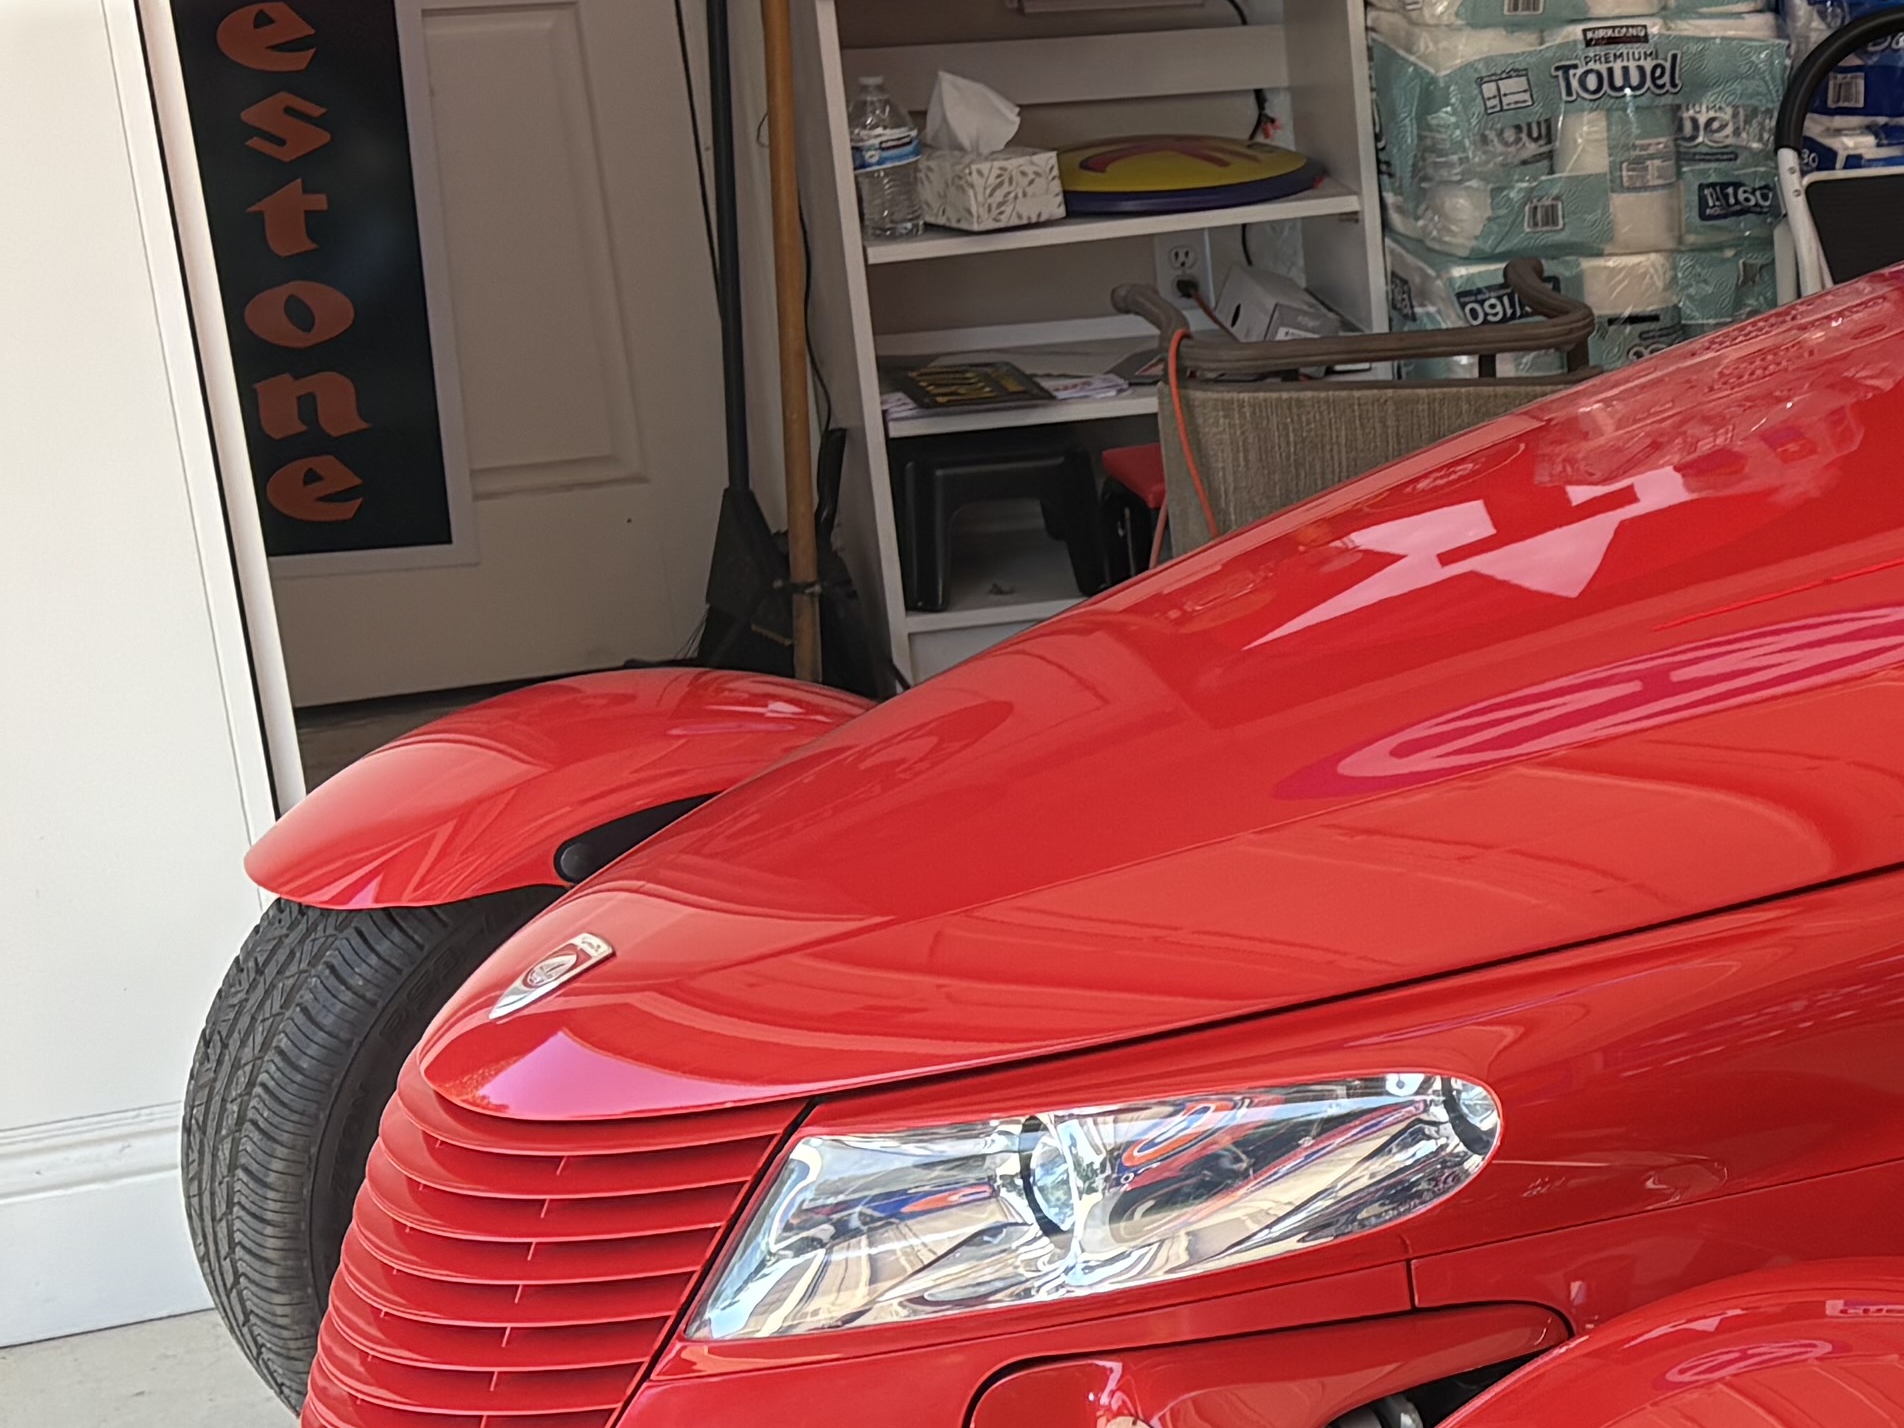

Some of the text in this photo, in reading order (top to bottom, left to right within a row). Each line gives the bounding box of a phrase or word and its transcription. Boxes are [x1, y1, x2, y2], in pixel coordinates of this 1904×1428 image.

[1554, 53, 1681, 100] Towel
[1726, 184, 1773, 208] 160
[1464, 295, 1512, 326] 160
